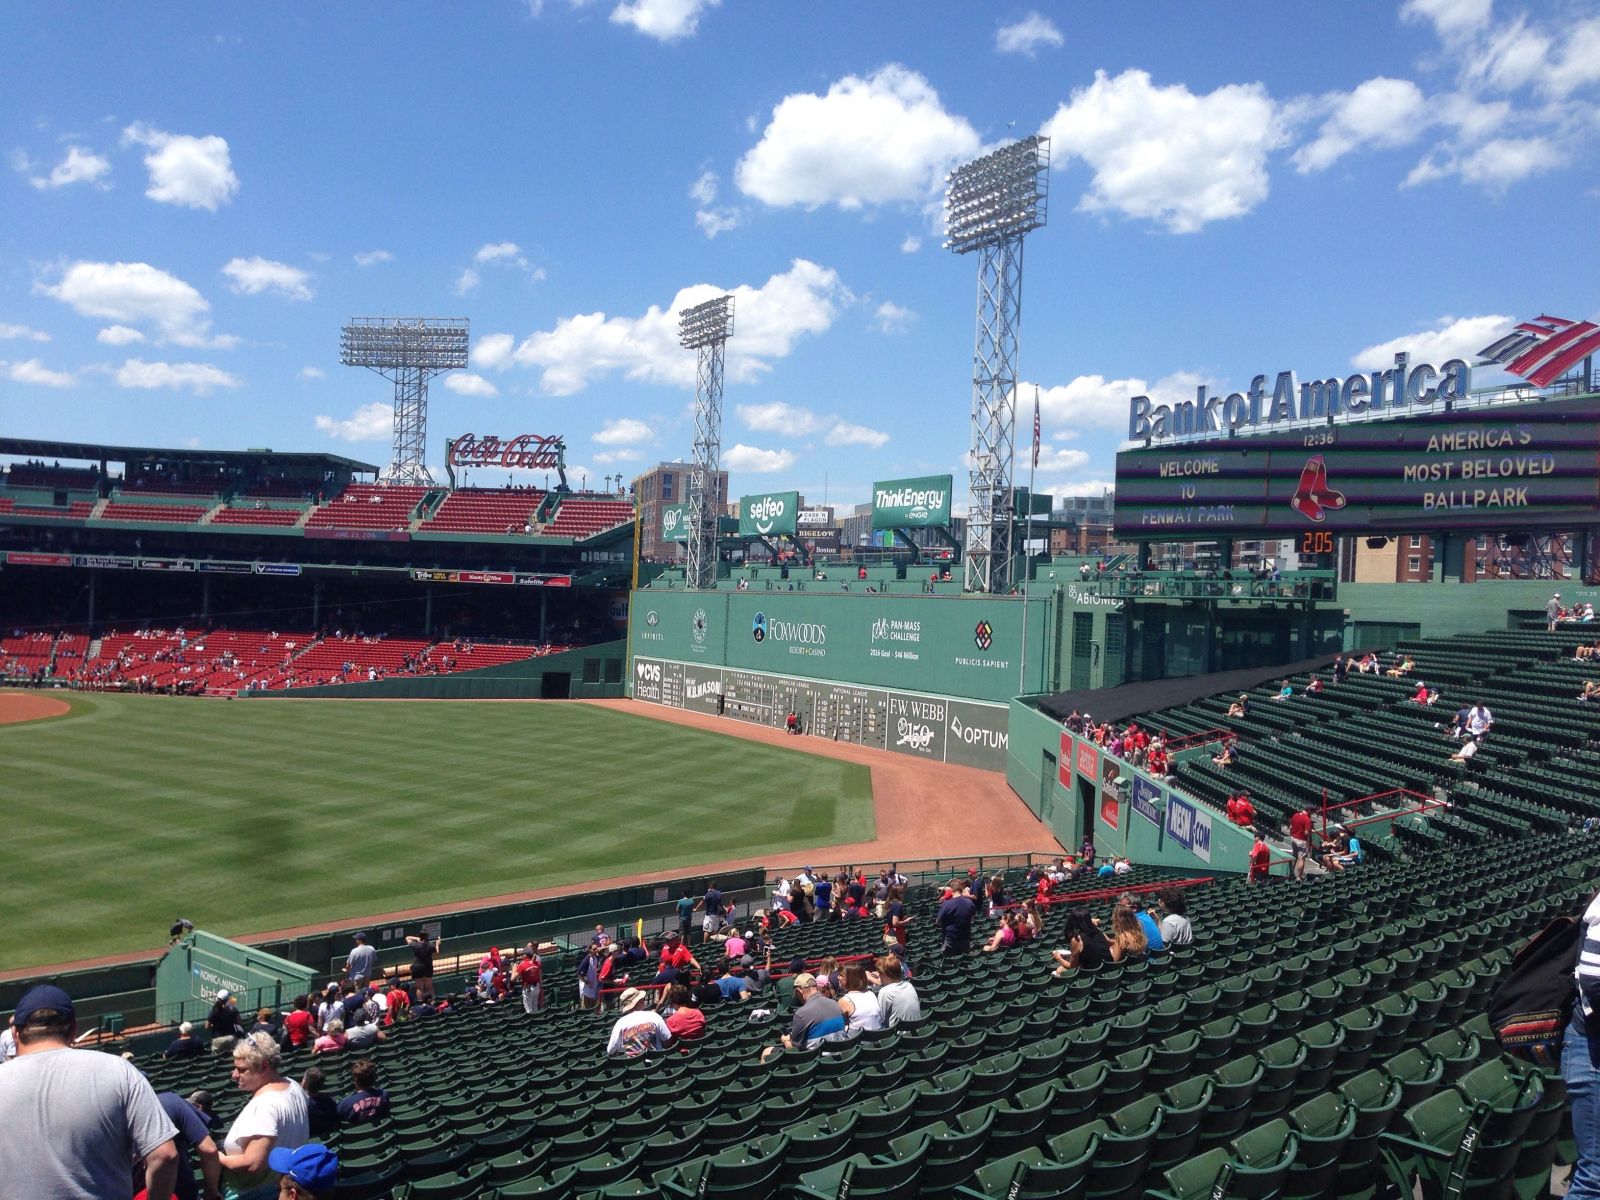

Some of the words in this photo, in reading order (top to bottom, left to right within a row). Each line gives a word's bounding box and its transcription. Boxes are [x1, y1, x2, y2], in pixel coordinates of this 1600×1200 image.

[1129, 385, 1222, 441] Bank
[1222, 374, 1269, 429] of
[1268, 352, 1472, 423] America
[1303, 432, 1334, 447] 12:36
[1426, 424, 1532, 453] AMERICA'S
[1159, 457, 1219, 477] WELCOME
[1404, 462, 1454, 482] MOST
[1461, 454, 1555, 480] BELOVED
[1181, 485, 1196, 499] TO
[1424, 487, 1528, 511] BALLPARK
[1142, 508, 1193, 525] FENWAY
[1198, 505, 1234, 522] PARK
[890, 620, 920, 631] PAN-MASS
[890, 631, 920, 642] CHALLENGE
[955, 657, 980, 666] PUBLICIS
[982, 659, 1009, 668] SAPIENT
[645, 664, 660, 682] CVS
[637, 680, 660, 699] Health
[911, 702, 944, 721] WEBB
[964, 727, 1009, 750] OPTUM
